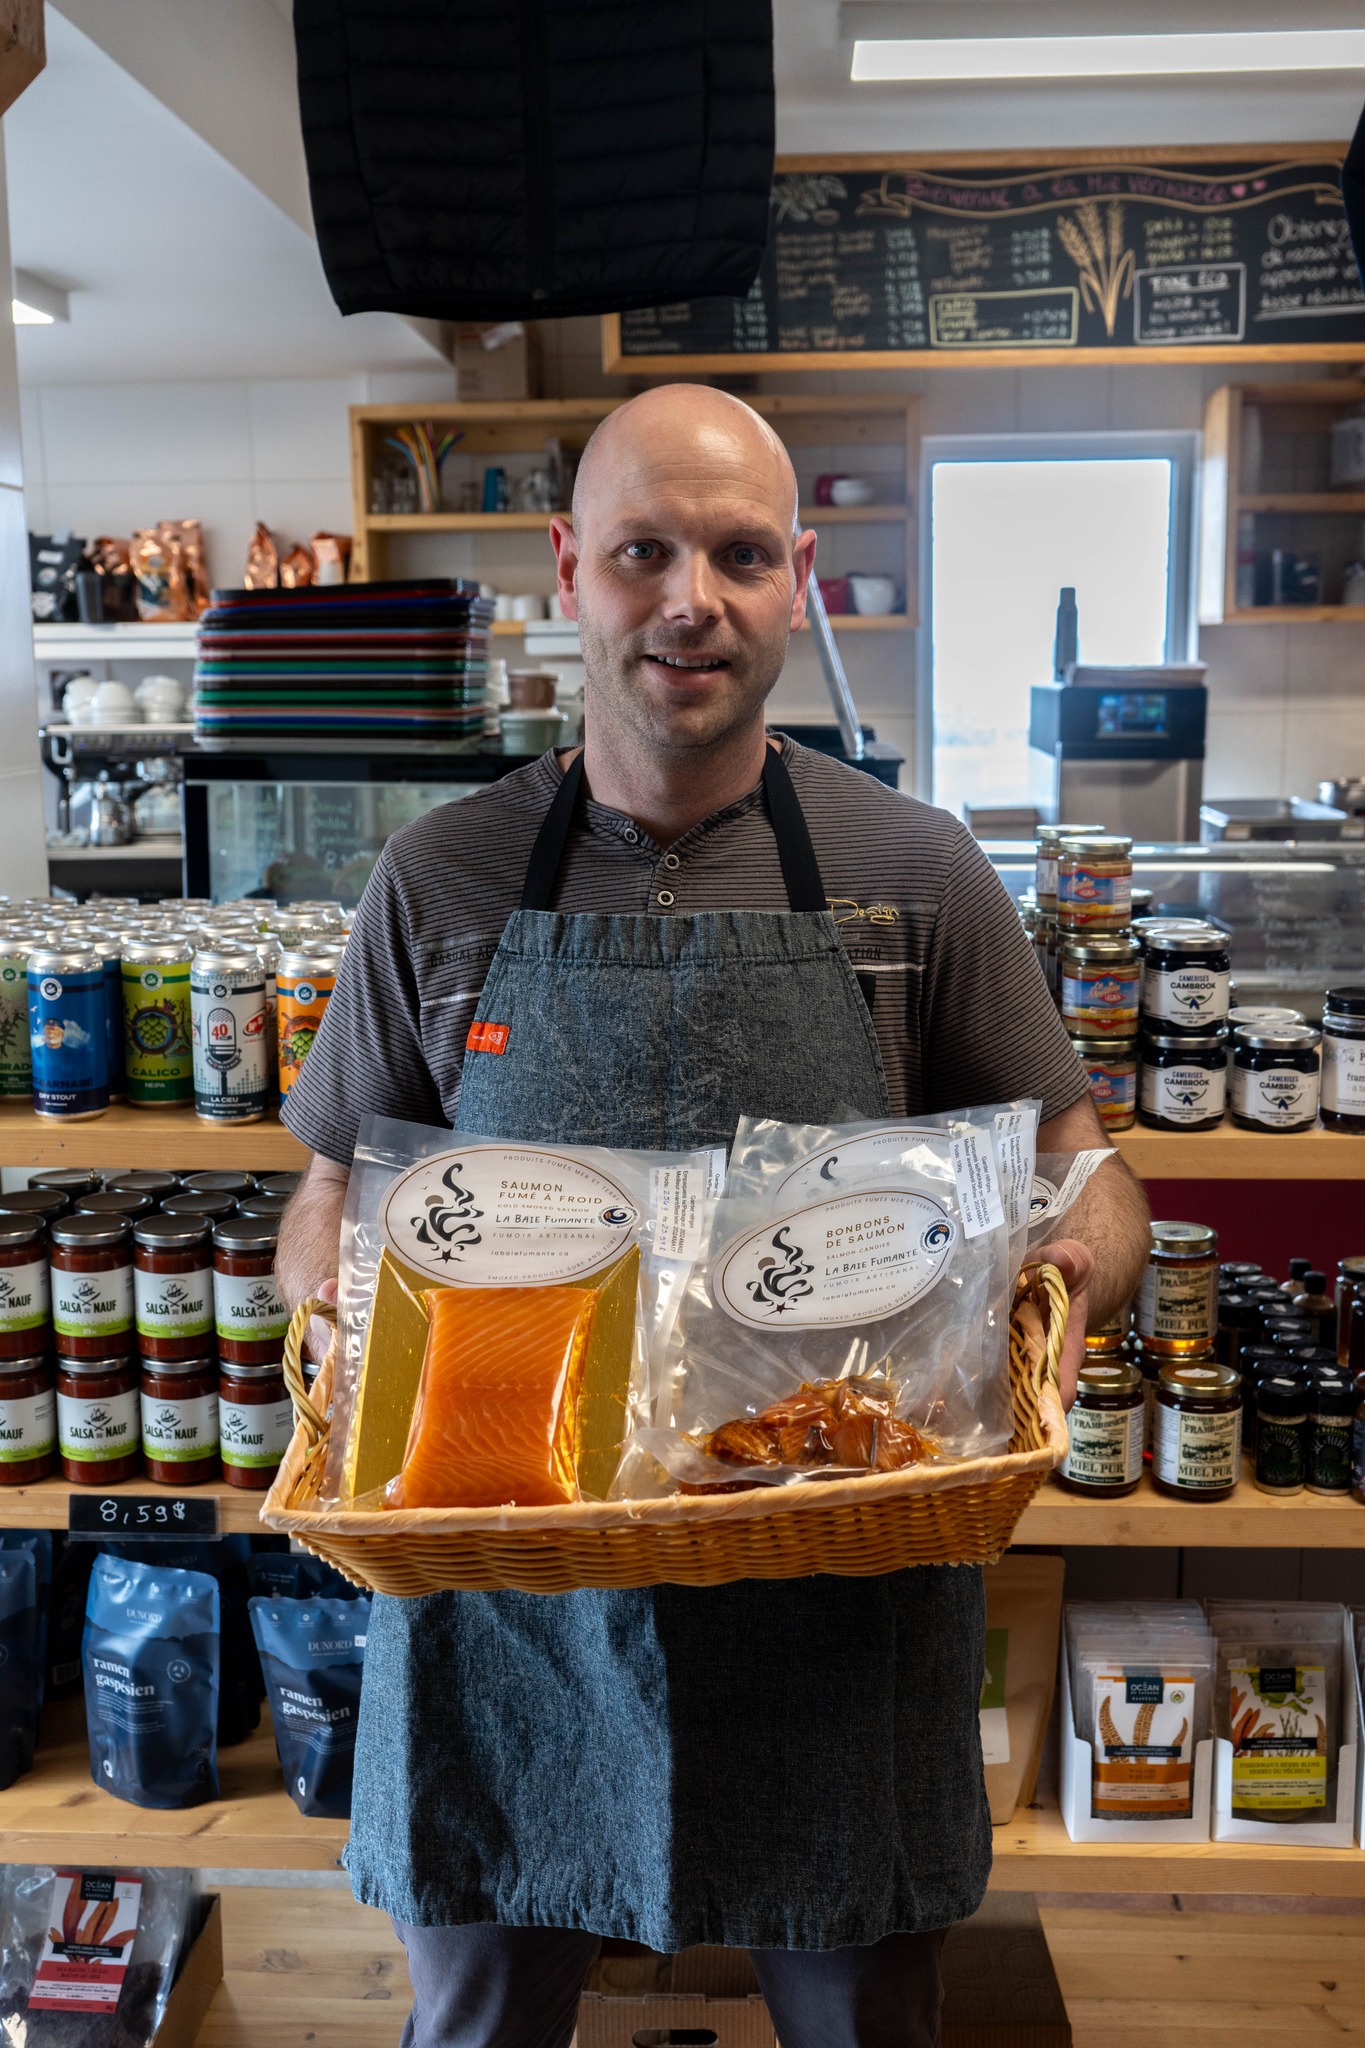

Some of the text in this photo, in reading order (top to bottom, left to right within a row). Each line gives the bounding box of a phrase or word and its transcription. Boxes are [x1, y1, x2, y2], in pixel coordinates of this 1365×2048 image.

[430, 948, 473, 967] CASUAL
[1170, 982, 1216, 990] CAMBROOK
[131, 1068, 180, 1077] CALICO
[1164, 1078, 1210, 1086] CAMBROOK
[1259, 1082, 1297, 1090] CAMBRO
[872, 1136, 909, 1146] PRODUITS
[503, 1155, 544, 1163] PRODUITS
[547, 1159, 572, 1171] FUMÉS
[574, 1169, 590, 1180] MER
[591, 1178, 600, 1186] ET
[501, 1180, 563, 1193] SAUMON
[499, 1190, 603, 1205] FUMÉ À FROID
[825, 1198, 862, 1212] PRODUITS
[915, 1201, 934, 1213] TERRE
[826, 1215, 890, 1238] BONBONS
[826, 1222, 905, 1249] DE SAUMON
[522, 1269, 564, 1279] PRODUCTS
[566, 1260, 585, 1272] SURF
[587, 1251, 602, 1263] AND
[602, 1236, 618, 1252] TURF
[826, 1241, 891, 1260] SALMON CANDIES
[823, 1264, 920, 1289] FUMOIR ARTISANAL
[822, 1284, 896, 1301] labaiefumante.ca
[852, 1302, 892, 1318] PRODUCTS
[894, 1291, 911, 1303] SURF
[913, 1278, 925, 1291] AND
[8, 1294, 32, 1308] NAUF
[59, 1300, 82, 1314] SALSA
[93, 1300, 117, 1313] NAUF
[145, 1302, 170, 1315] SALSA
[181, 1300, 204, 1314] NAUF
[231, 1306, 257, 1318] SALSA
[268, 1303, 285, 1317] NAU
[1155, 1319, 1208, 1330] MIEL PUR
[69, 1426, 94, 1439] SALSA
[105, 1423, 128, 1438] NAUF
[144, 1424, 164, 1439] SALSA
[174, 1427, 198, 1439] NAUF
[241, 1434, 264, 1445] NAUF
[1069, 1458, 1124, 1474] MIEL PUR
[1179, 1465, 1233, 1478] MIEL PUR
[99, 1500, 186, 1525] 8,59$
[126, 1608, 162, 1623] DUNORD
[307, 1640, 353, 1652] DUNORD
[93, 1657, 130, 1679] ramen
[95, 1673, 155, 1697] gaspésien
[279, 1686, 323, 1707] ramen
[282, 1701, 351, 1723] gaspésien
